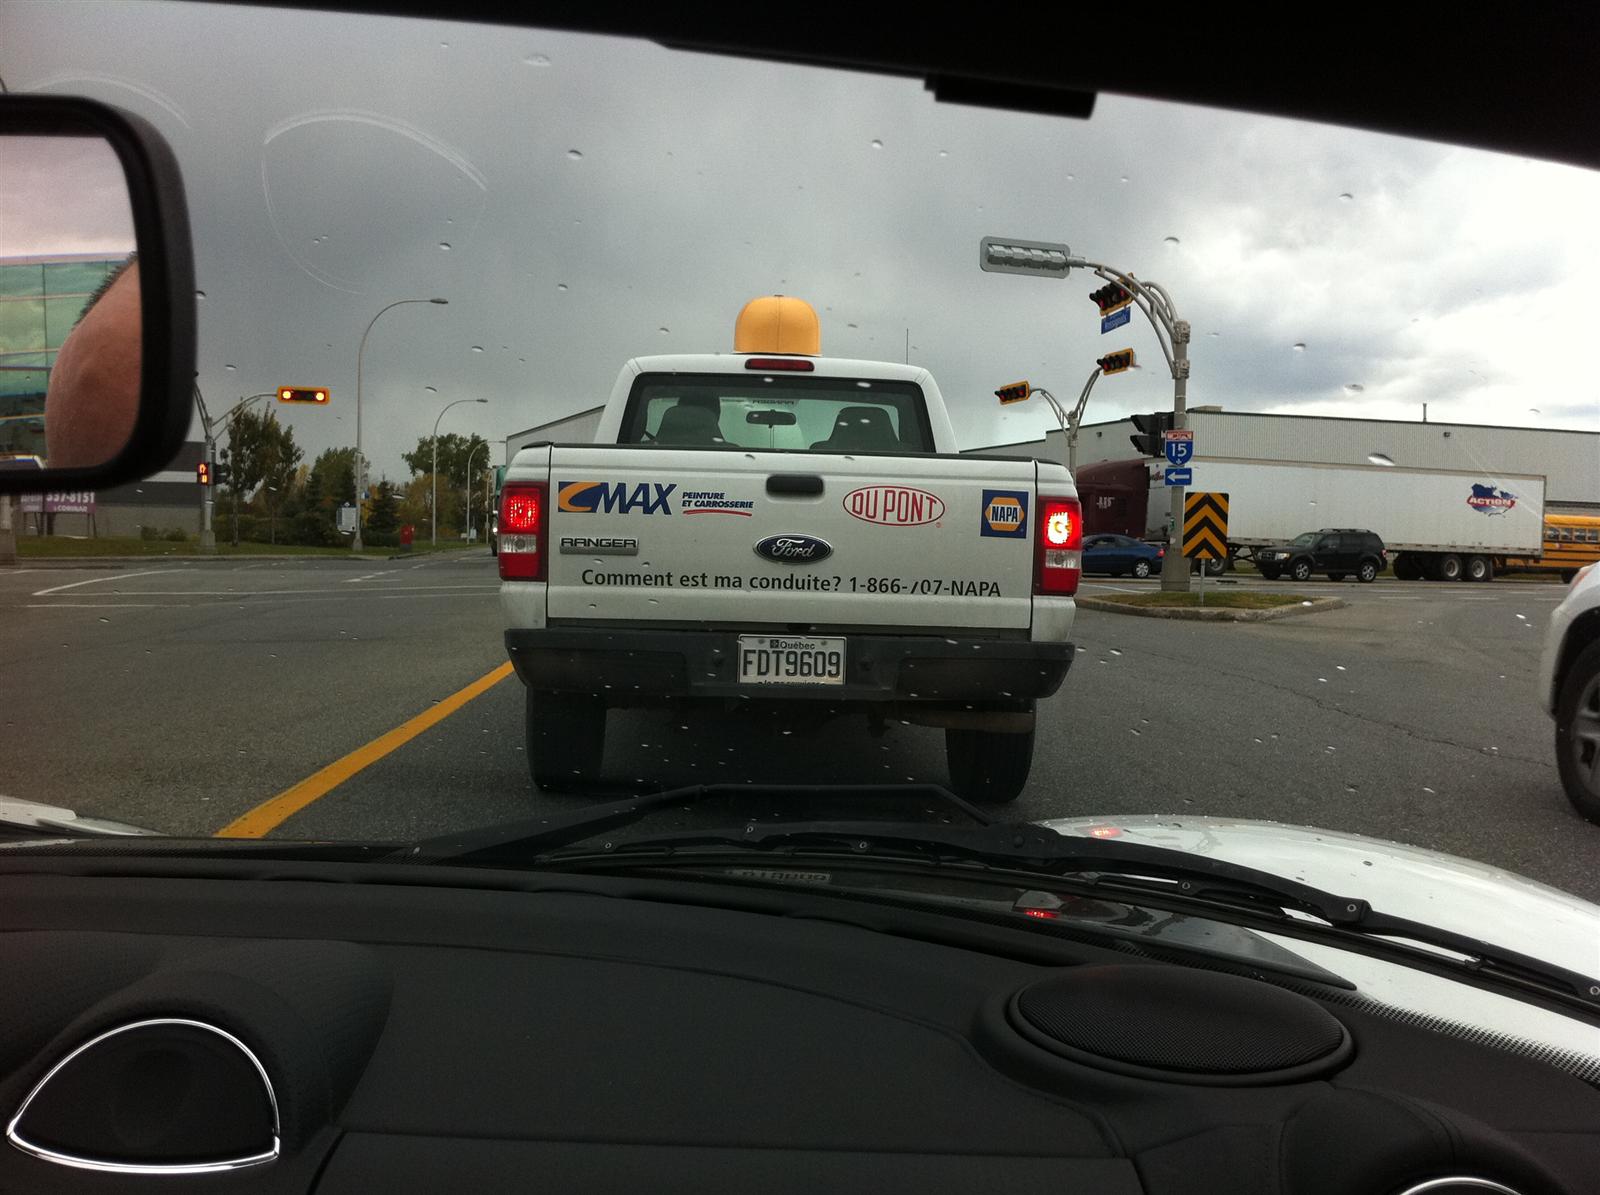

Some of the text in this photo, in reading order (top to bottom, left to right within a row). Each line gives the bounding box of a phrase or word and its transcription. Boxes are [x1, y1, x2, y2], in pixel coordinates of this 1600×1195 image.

[1171, 443, 1187, 457] 15
[682, 491, 725, 500] PEINTURE
[682, 500, 754, 509] ET CARROSSERIE
[1469, 497, 1512, 507] ACTION
[991, 506, 1019, 523] NAPA
[560, 538, 637, 548] RANGER
[771, 538, 816, 557] Ford
[581, 569, 673, 587] Comment
[680, 572, 708, 587] est
[714, 574, 742, 588] ma
[750, 573, 842, 592] conduite?
[780, 640, 816, 650] Québec
[743, 649, 841, 678] FDT9609
